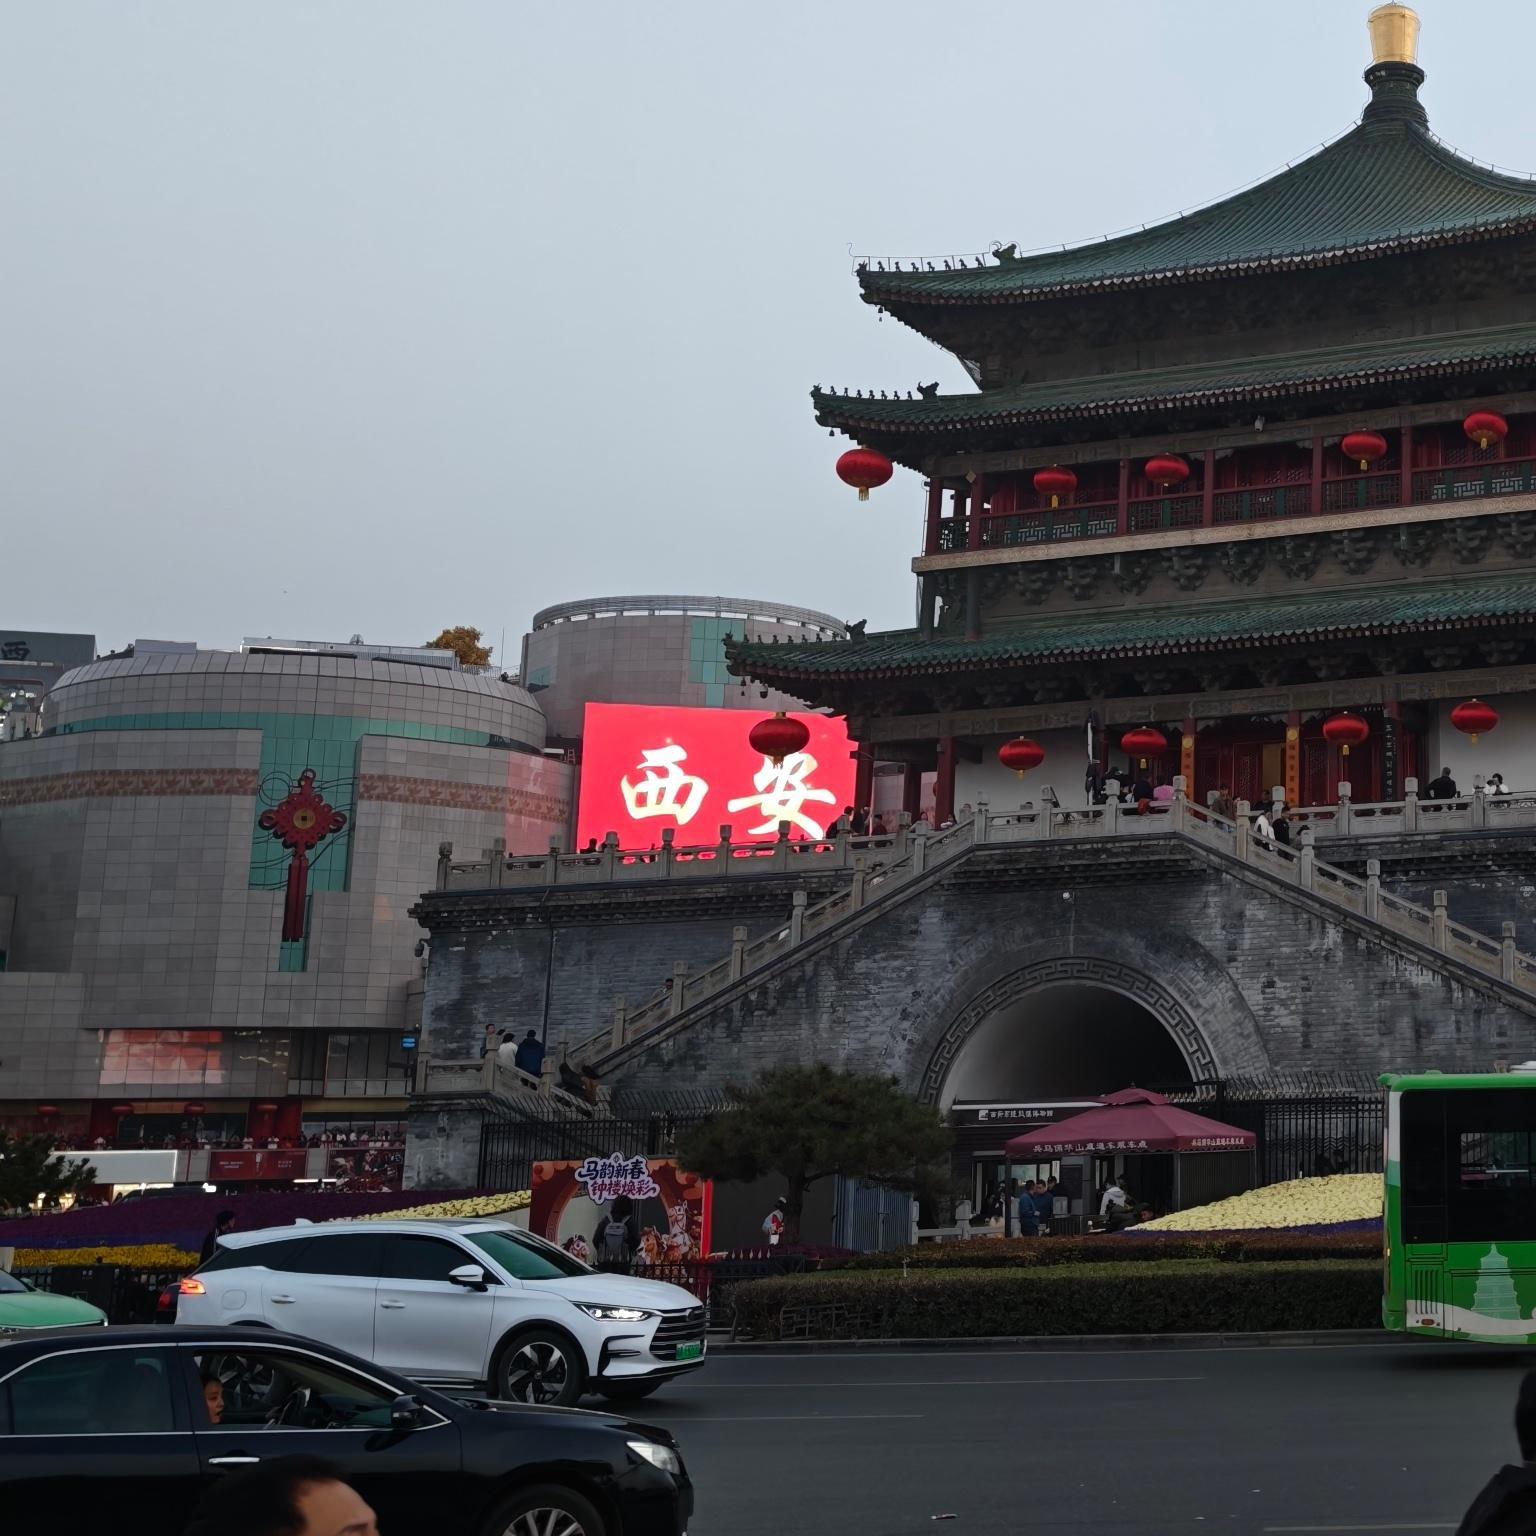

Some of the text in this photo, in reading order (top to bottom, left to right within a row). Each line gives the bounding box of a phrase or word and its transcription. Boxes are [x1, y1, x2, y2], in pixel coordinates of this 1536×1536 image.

[620, 744, 837, 841] 西安
[578, 1158, 646, 1180] 马韵新春
[590, 1180, 656, 1200] 钟楼焕彩
